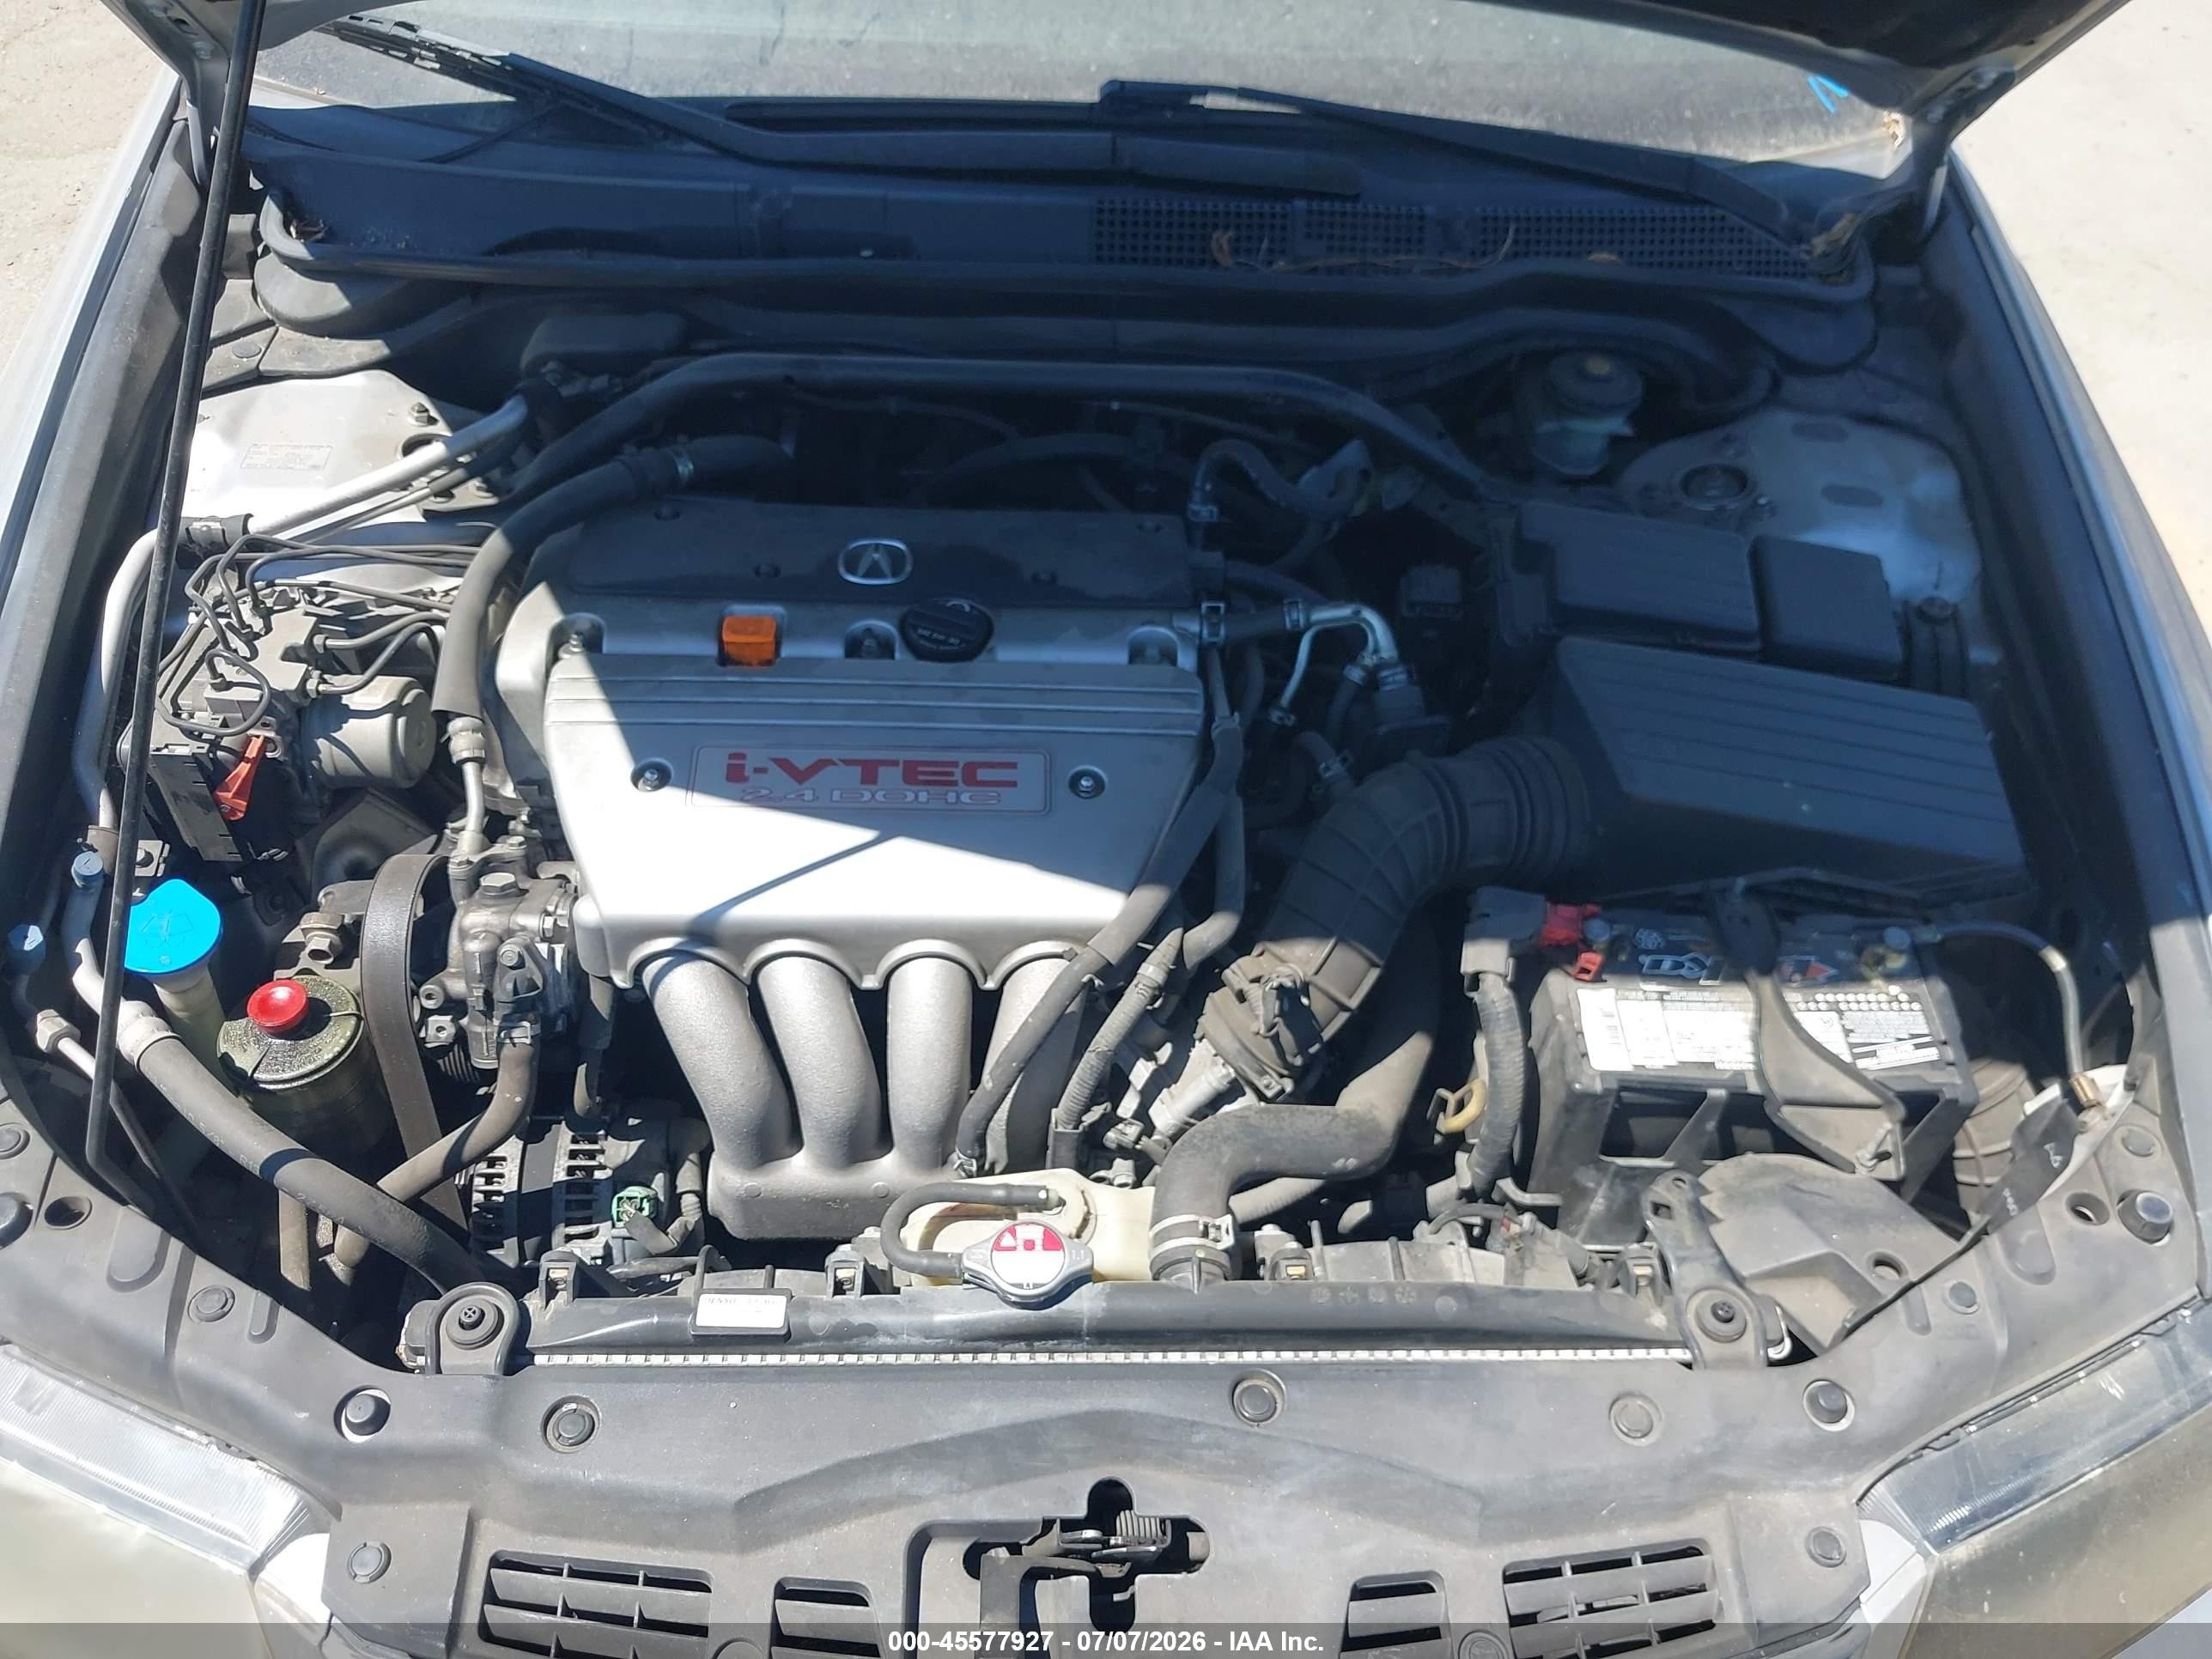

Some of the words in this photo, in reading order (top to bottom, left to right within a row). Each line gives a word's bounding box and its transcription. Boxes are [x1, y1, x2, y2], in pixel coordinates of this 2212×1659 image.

[726, 752, 1018, 787] i-VTEC
[741, 787, 819, 803] 2.4
[830, 789, 1001, 805] DOHC
